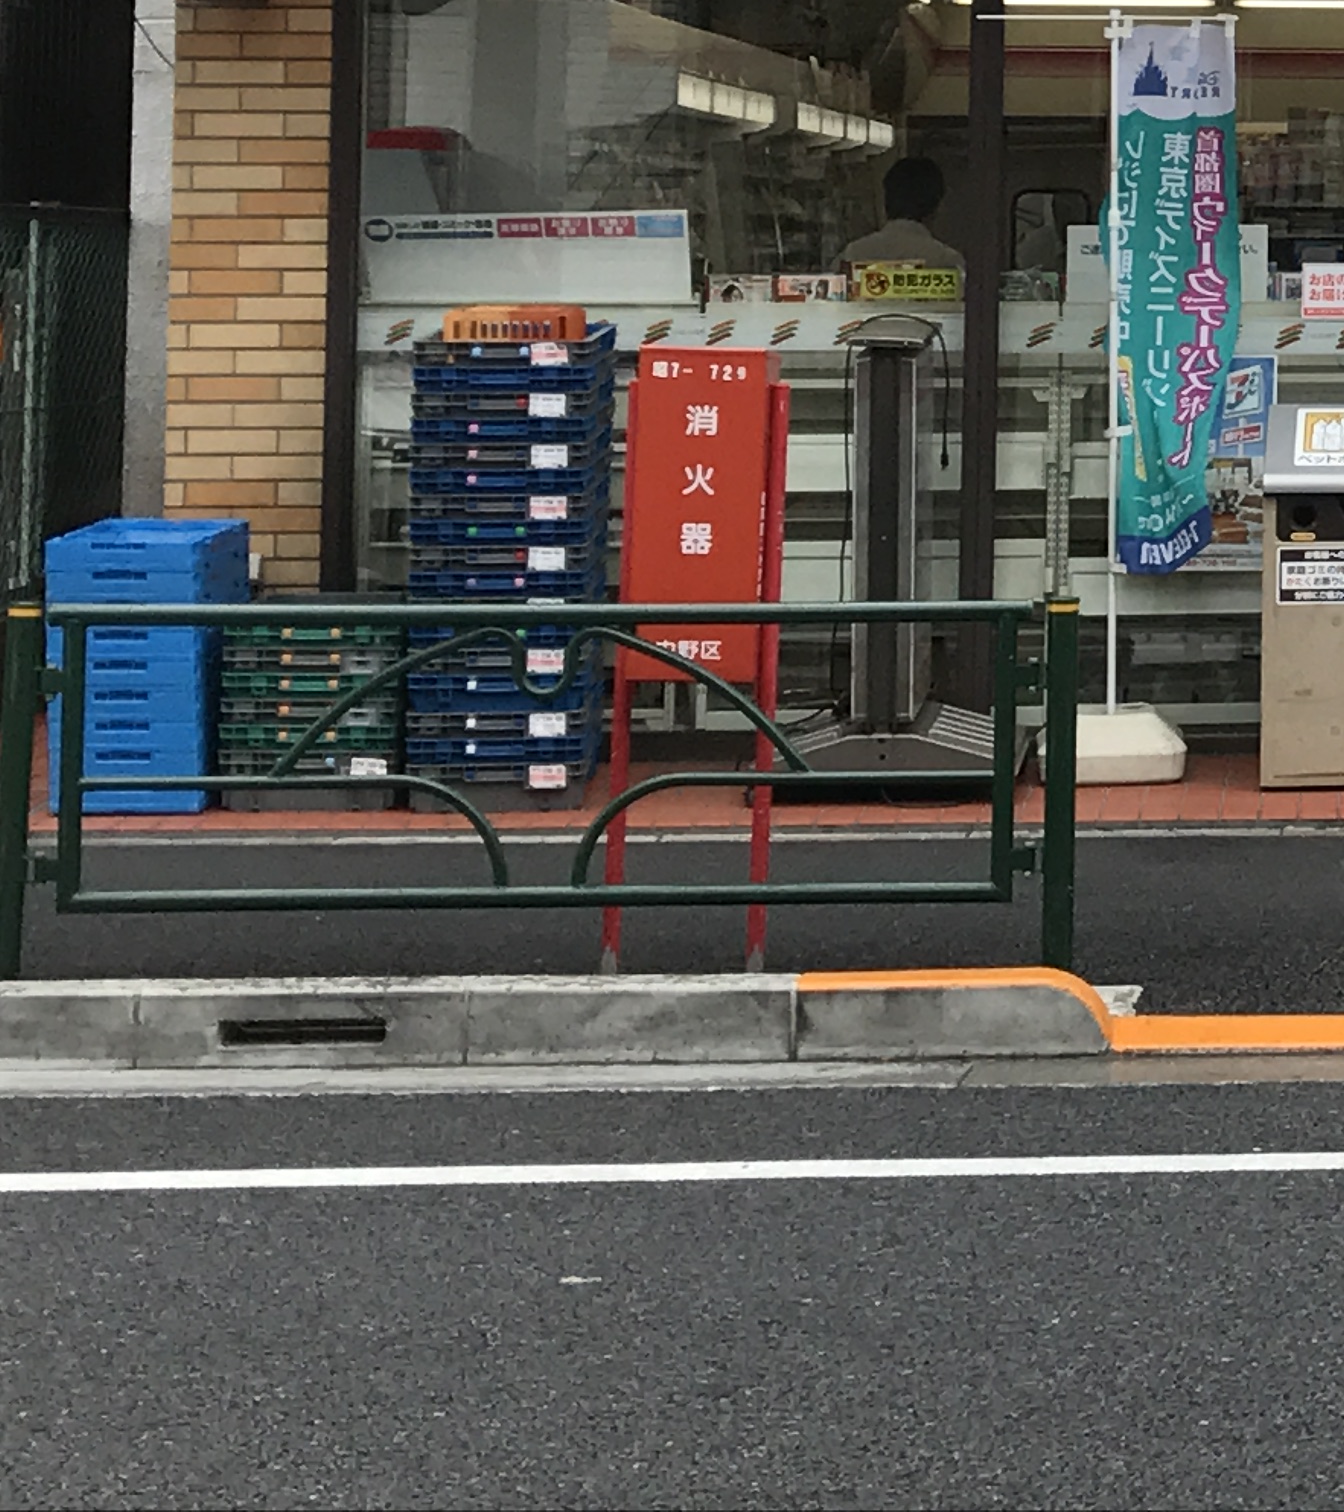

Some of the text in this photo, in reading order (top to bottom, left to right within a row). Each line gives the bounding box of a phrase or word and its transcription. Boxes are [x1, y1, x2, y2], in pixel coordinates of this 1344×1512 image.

[709, 363, 747, 382] 729
[680, 403, 719, 555] 消火器
